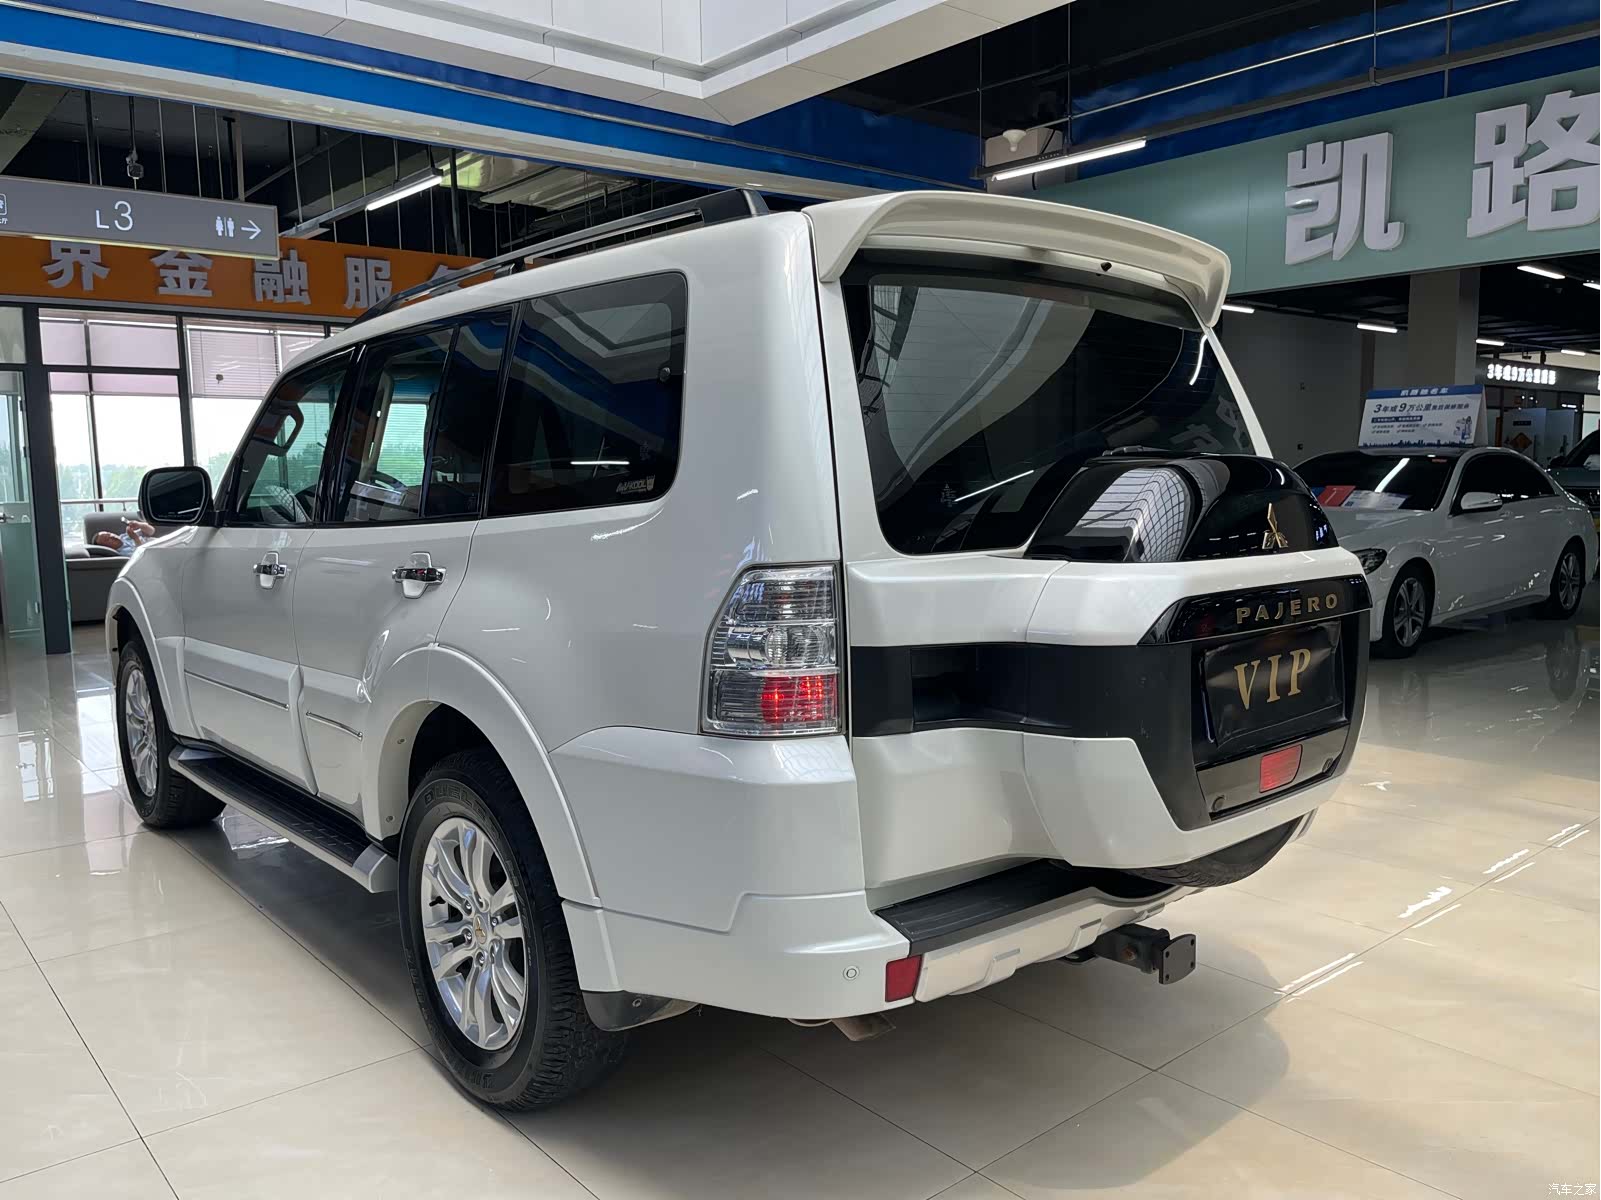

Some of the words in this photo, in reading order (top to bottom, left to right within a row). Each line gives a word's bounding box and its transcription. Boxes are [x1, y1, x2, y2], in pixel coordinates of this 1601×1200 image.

[1285, 90, 1601, 265] 凯路
[95, 200, 134, 231] L3
[1236, 593, 1338, 624] PAJERO
[1233, 648, 1312, 711] VIP
